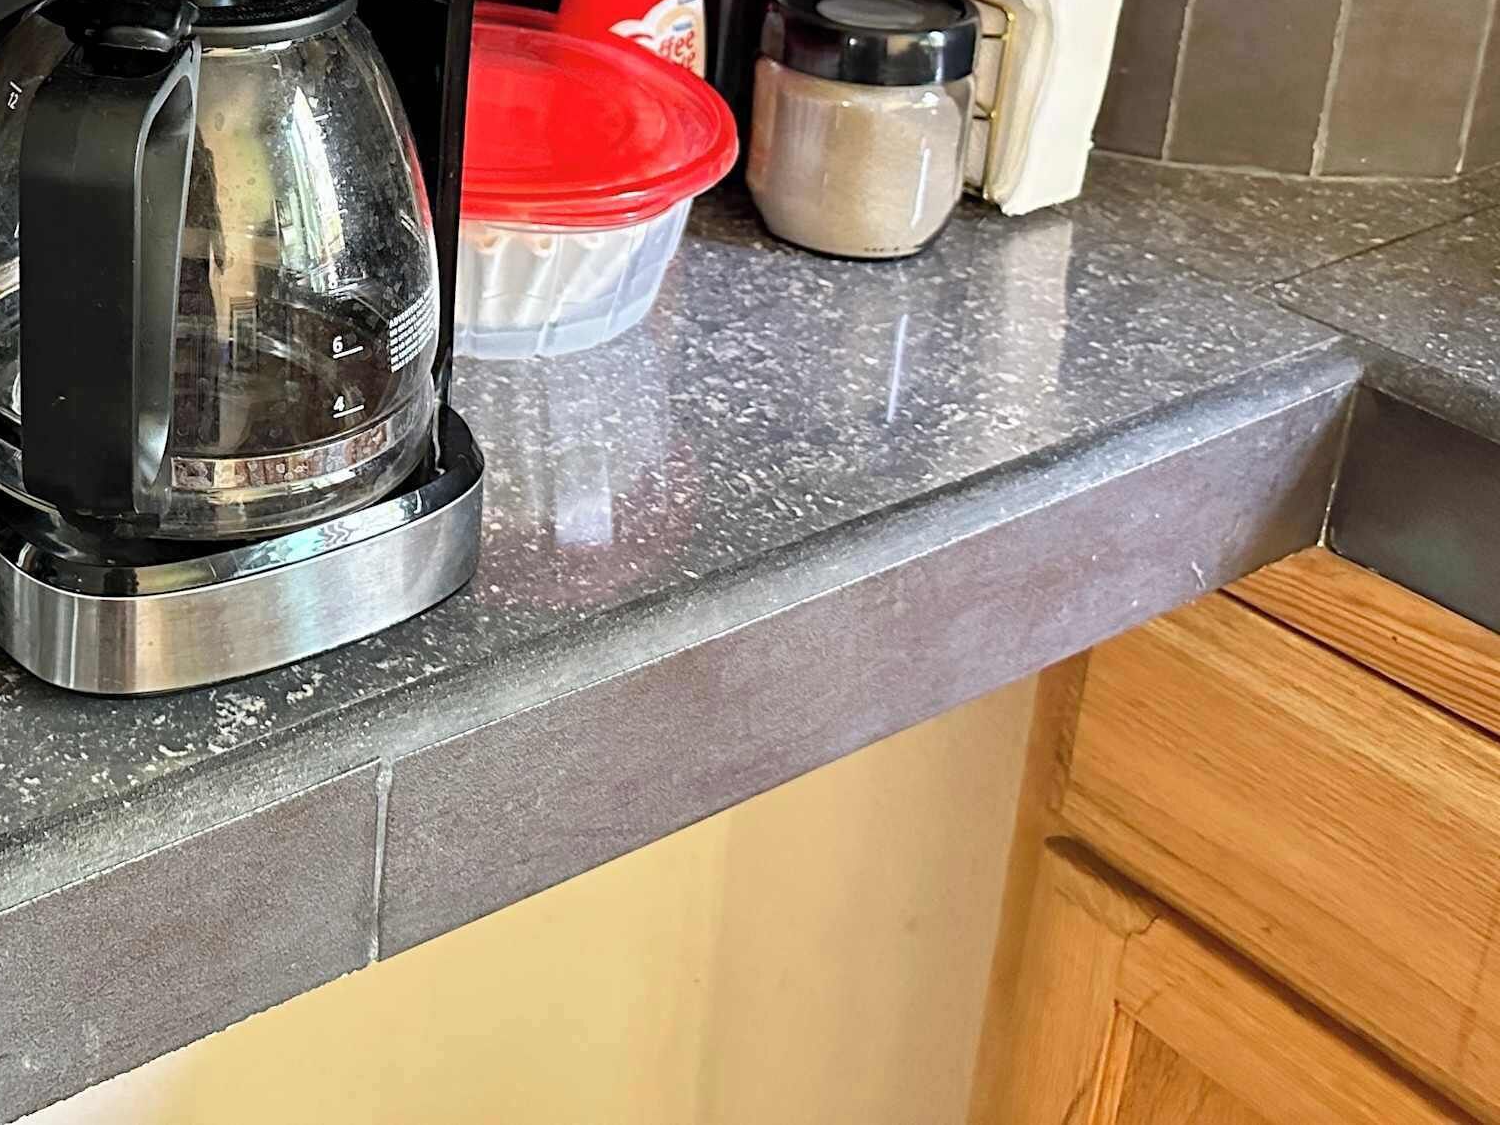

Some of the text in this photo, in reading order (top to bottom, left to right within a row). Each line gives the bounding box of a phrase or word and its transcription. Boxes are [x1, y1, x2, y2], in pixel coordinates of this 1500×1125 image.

[659, 30, 694, 58] ffee
[7, 91, 19, 110] 12
[332, 335, 344, 354] 6
[333, 395, 345, 412] 4
